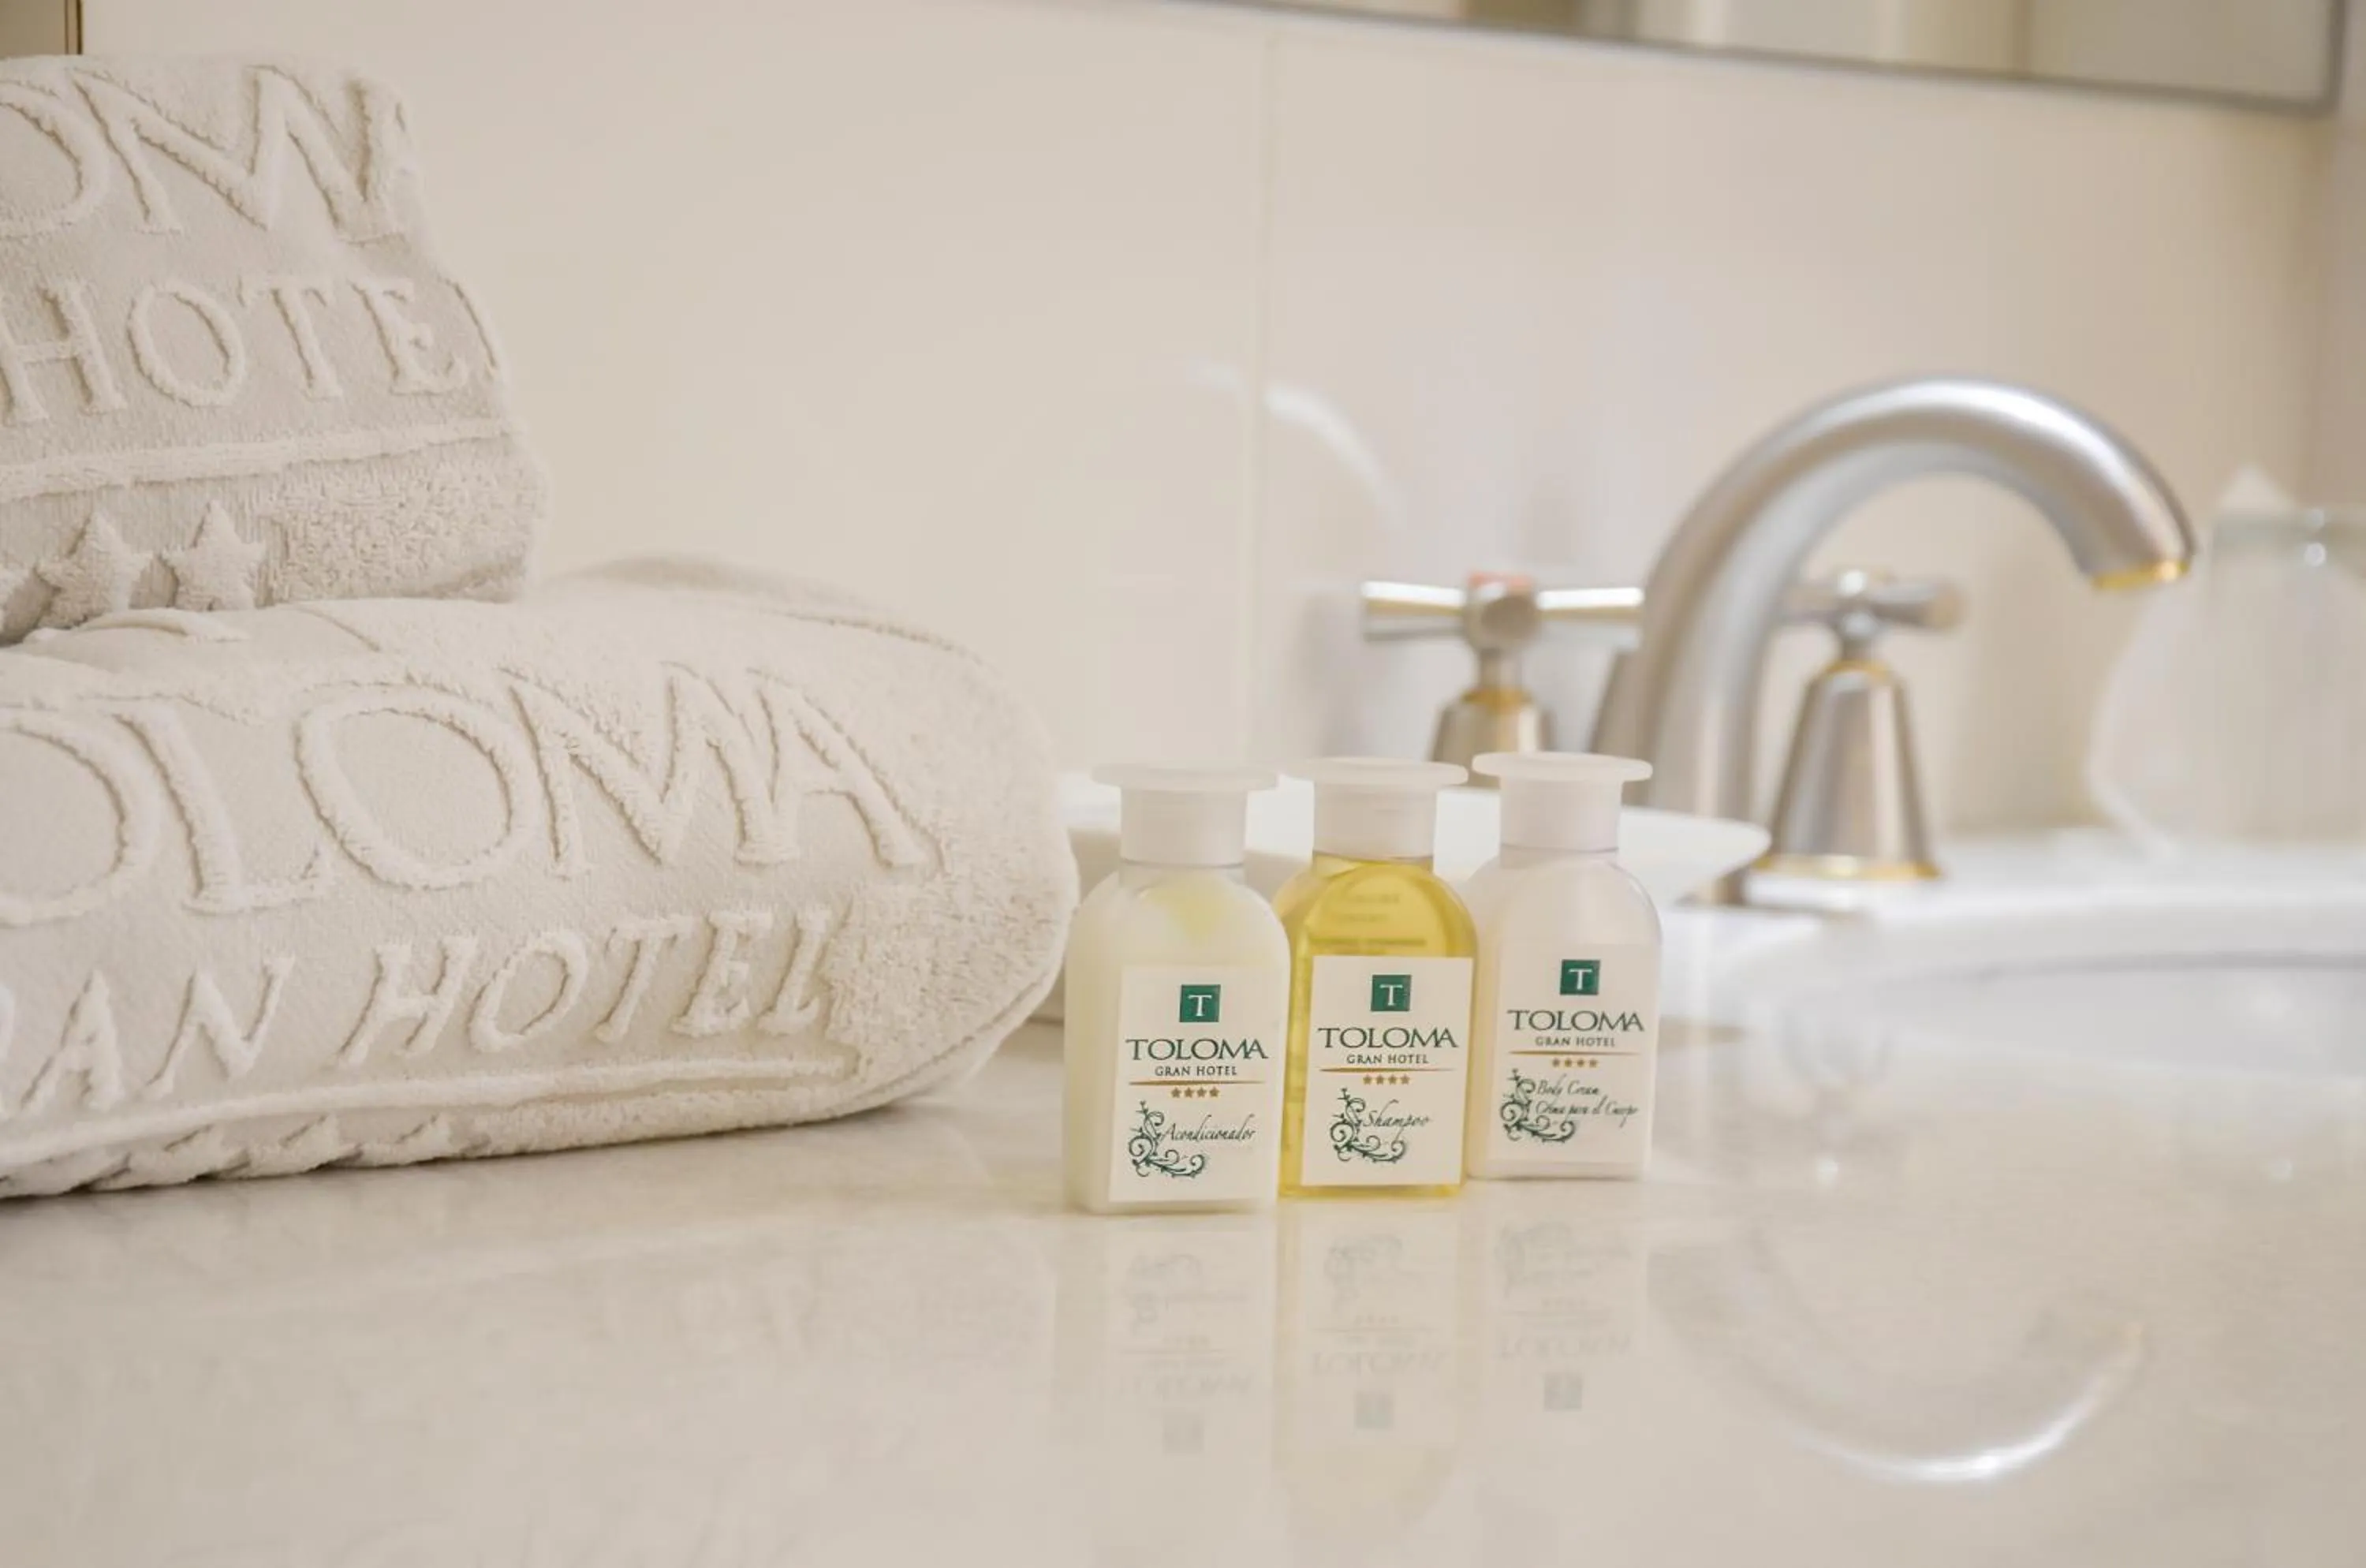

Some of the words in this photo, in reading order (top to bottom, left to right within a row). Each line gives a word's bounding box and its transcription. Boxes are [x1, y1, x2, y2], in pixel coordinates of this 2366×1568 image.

[1568, 968, 1593, 991] T
[1188, 994, 1212, 1017] T
[1379, 984, 1404, 1006] T
[0, 949, 296, 1118] AN
[327, 905, 834, 1071] HOTEL
[1506, 1009, 1645, 1032] TOLOMA
[1125, 1037, 1270, 1061] TOLOMA
[1317, 1026, 1459, 1049] TOLOMA
[1534, 1036, 1571, 1047] GRAN
[1575, 1036, 1616, 1047] HOTEL
[1346, 1054, 1383, 1065] GRAN
[1387, 1053, 1429, 1065] HOTEL
[1154, 1066, 1192, 1077] GRAN
[1196, 1065, 1238, 1077] HOTEL
[1363, 1099, 1431, 1141] Shampoo
